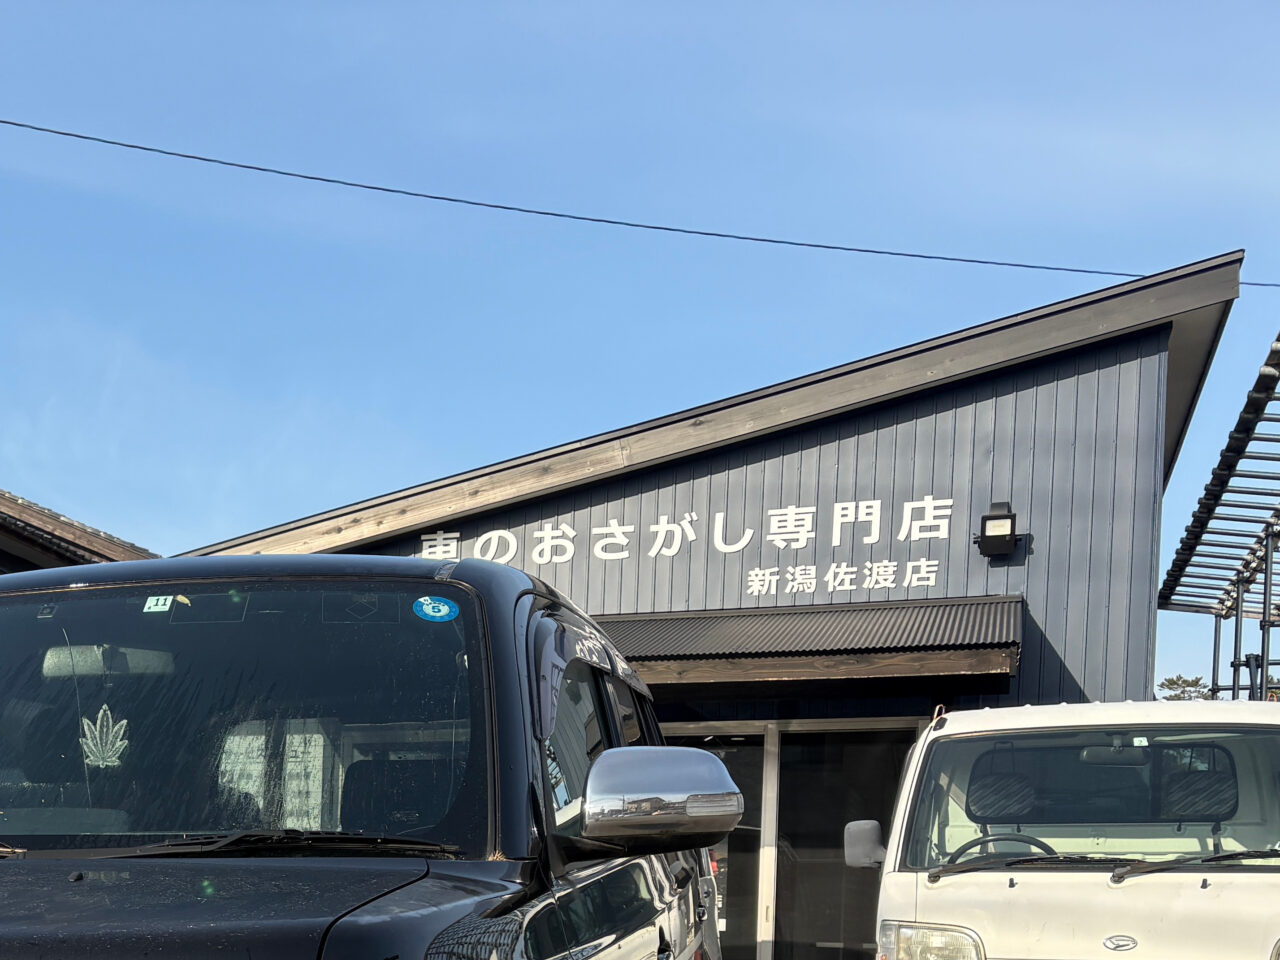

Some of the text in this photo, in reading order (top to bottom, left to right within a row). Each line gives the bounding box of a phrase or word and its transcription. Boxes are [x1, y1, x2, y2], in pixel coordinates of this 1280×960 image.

[746, 558, 939, 597] 新潟佐渡店
[431, 605, 442, 613] 5
